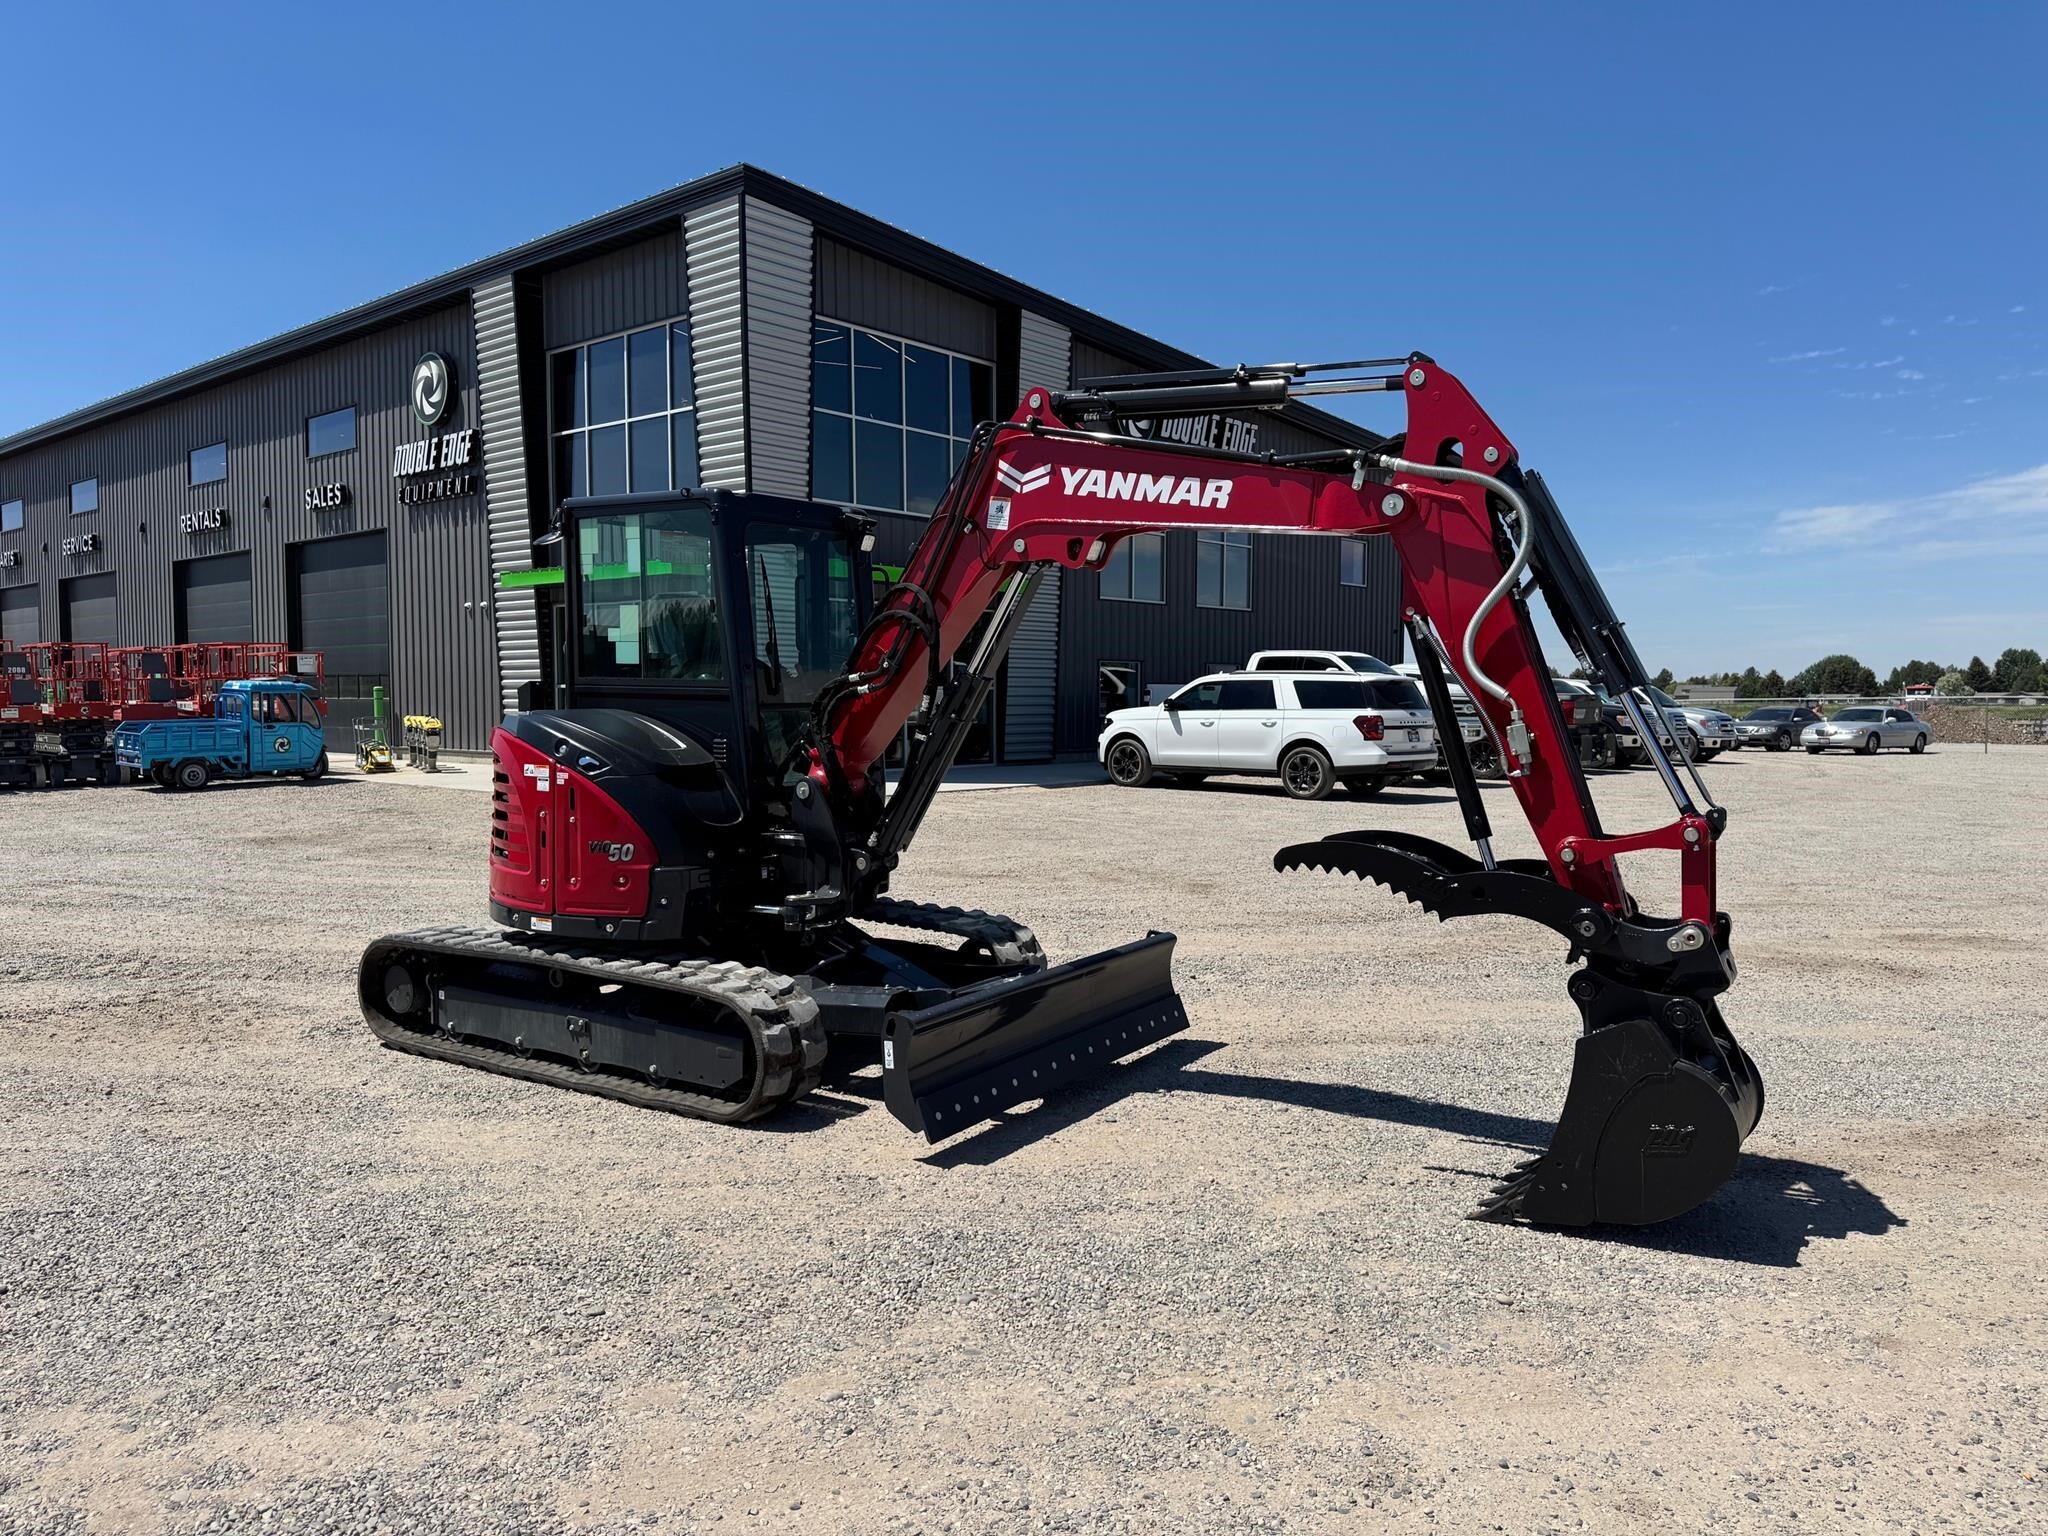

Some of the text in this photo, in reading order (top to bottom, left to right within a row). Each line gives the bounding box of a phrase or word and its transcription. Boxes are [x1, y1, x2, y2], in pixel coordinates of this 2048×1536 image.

[1161, 414, 1258, 454] DOUBLE EDGE
[393, 430, 473, 477] DOUBLE EDGE
[305, 483, 342, 510] SALES
[398, 475, 470, 504] EQUIPMENT
[1061, 467, 1233, 509] YANMAR
[180, 508, 220, 534] RENTALS
[63, 534, 93, 556] SERVICE
